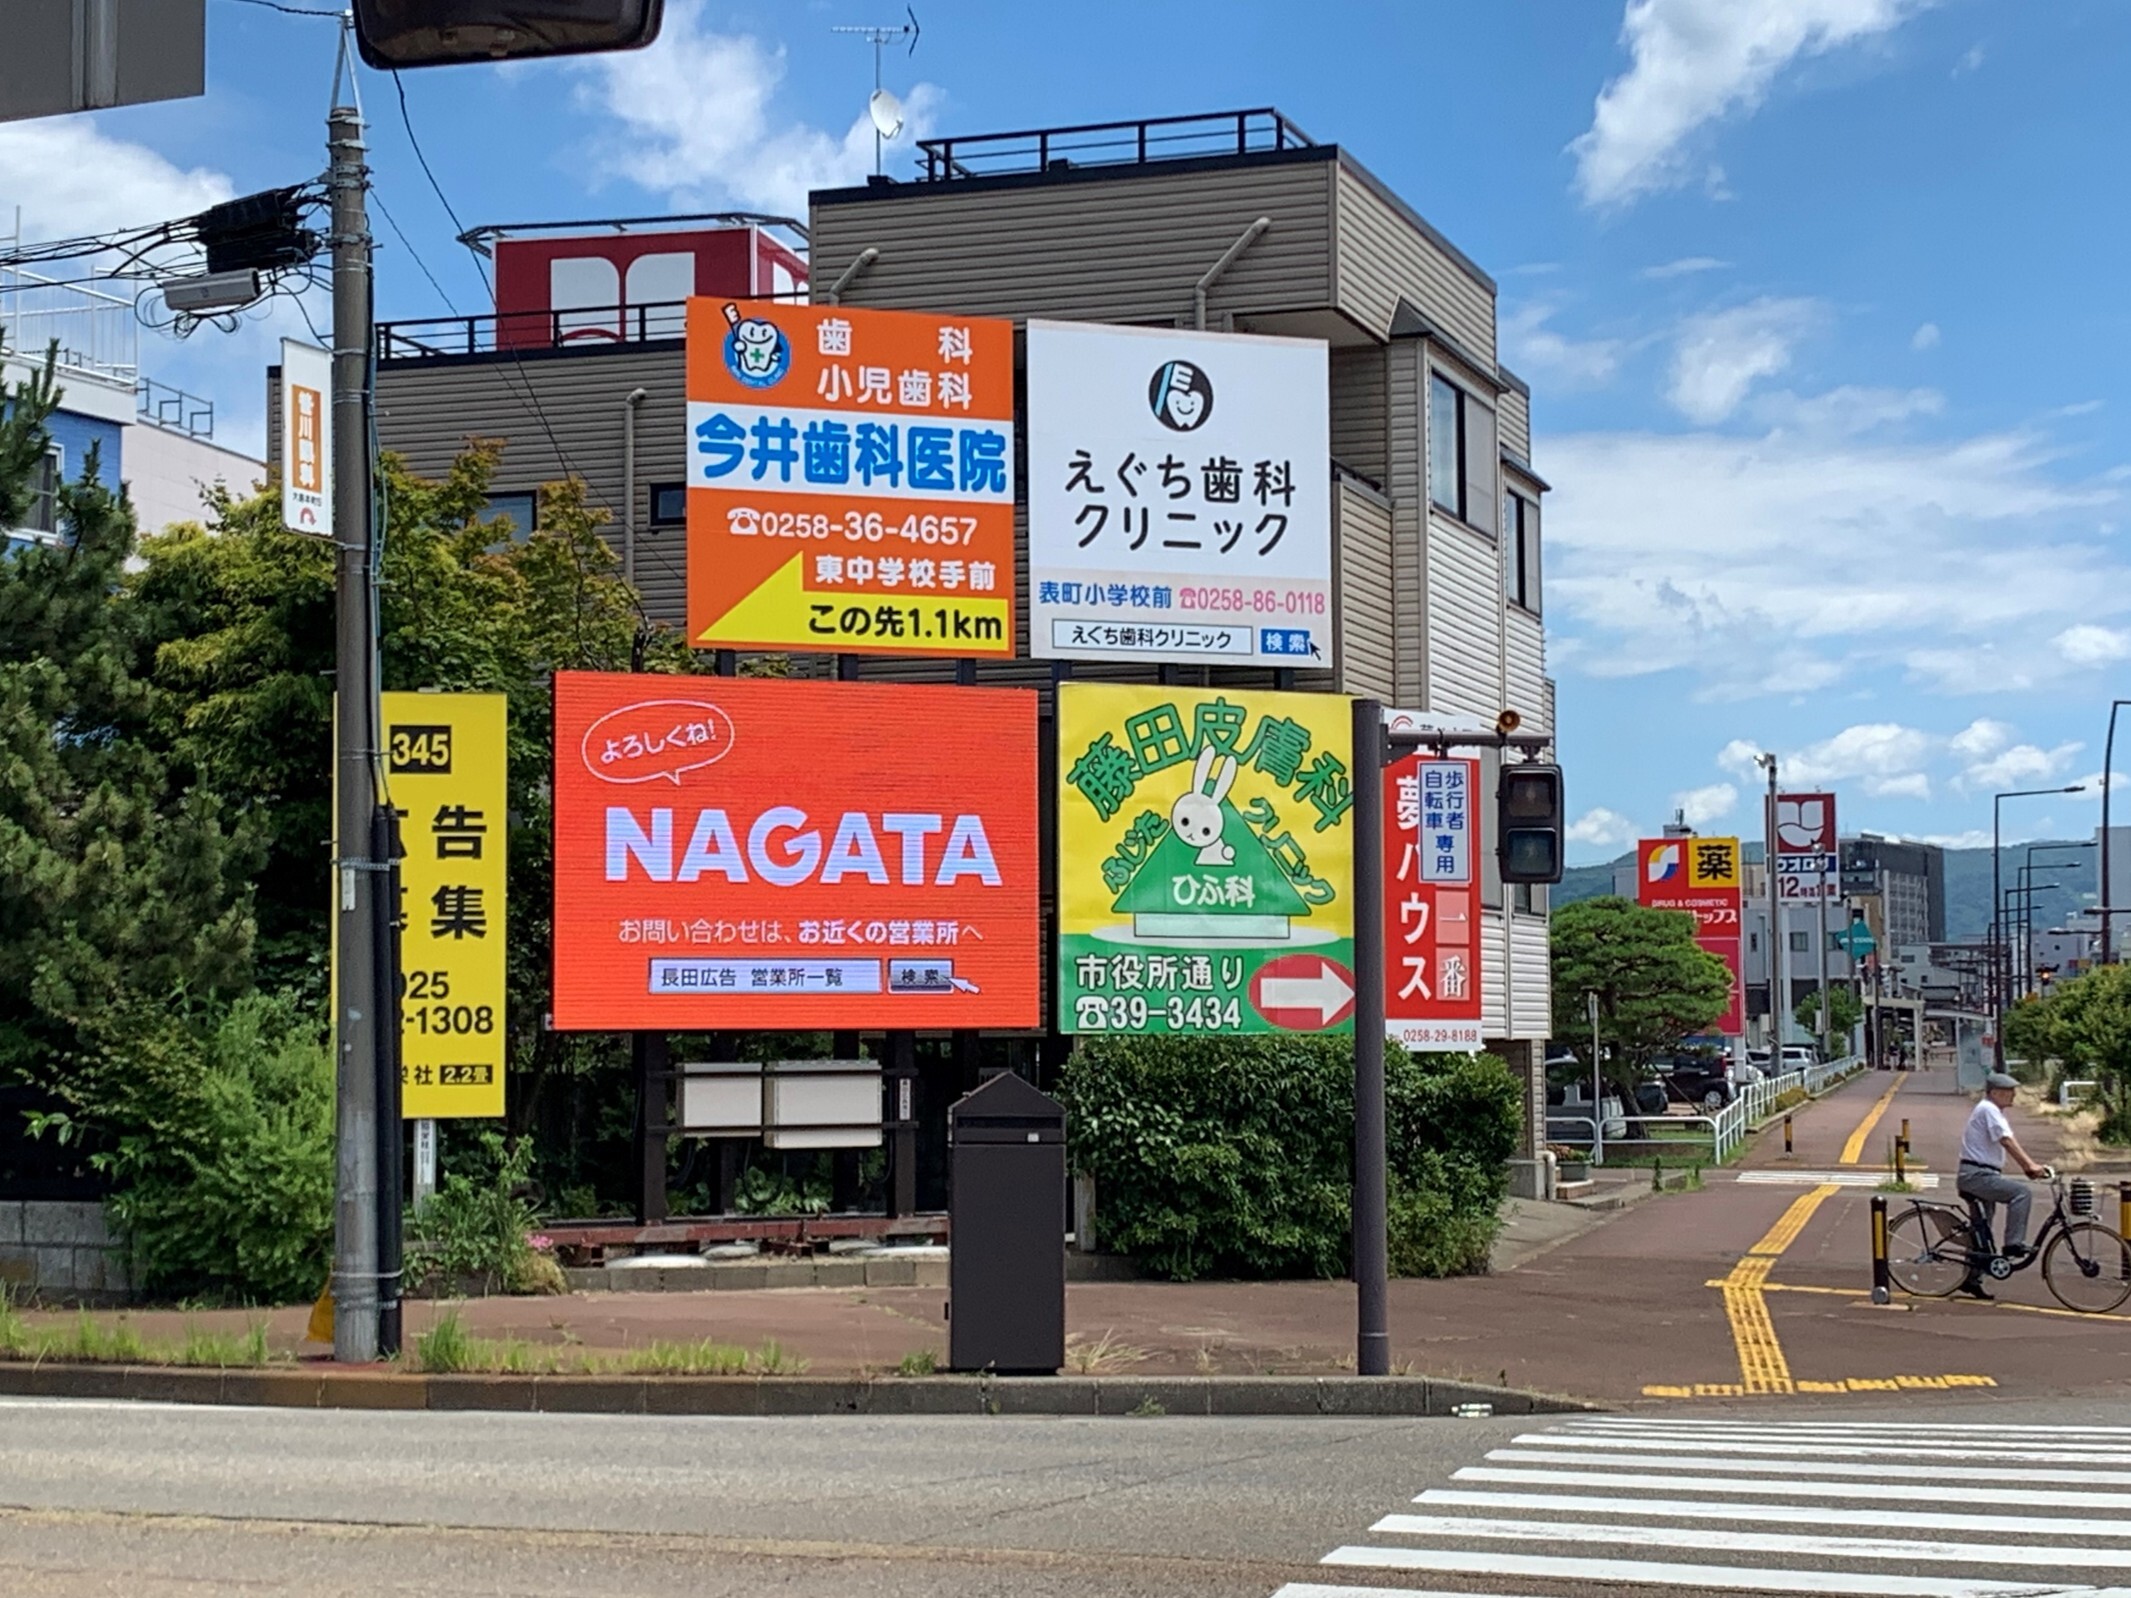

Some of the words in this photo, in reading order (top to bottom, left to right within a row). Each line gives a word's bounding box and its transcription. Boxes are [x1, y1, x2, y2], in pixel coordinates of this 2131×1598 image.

[817, 365, 973, 410] 小児歯科
[696, 413, 1007, 493] 今井歯科医院
[1065, 450, 1296, 507] えぐち歯科
[761, 510, 979, 546] 0258-36-4657
[1075, 505, 1289, 557] クリニック
[815, 555, 996, 591] 東中学校手前
[1038, 581, 1173, 610] 表町小学校前
[1198, 589, 1326, 616] 0258-86-0118
[808, 606, 1002, 641] この先1.1km
[1071, 626, 1232, 650] えぐち歯科クリニック
[1265, 633, 1306, 654] 検索
[392, 733, 449, 766] 345
[600, 719, 717, 764] よろしくね!
[1066, 696, 1354, 833] 藤田皮膚科
[1425, 770, 1443, 830] 自転車
[1446, 770, 1465, 830] 歩行者
[605, 805, 1003, 887] NAGATA
[1101, 810, 1170, 895] ふじた
[1435, 834, 1454, 873] 専用
[1697, 844, 1733, 880] 薬
[1172, 873, 1255, 909] ひふ科
[617, 919, 984, 945] お問い合わせは、お近くの営業所へ
[661, 968, 737, 987] 長田広告
[750, 967, 843, 987] 営業所一覧
[1076, 954, 1244, 991] 市役所通り
[401, 1005, 494, 1035] -1308
[1110, 998, 1242, 1029] 39-3434
[1403, 1028, 1477, 1043] 0258-29-8188
[444, 1067, 489, 1084] 2.2畳
